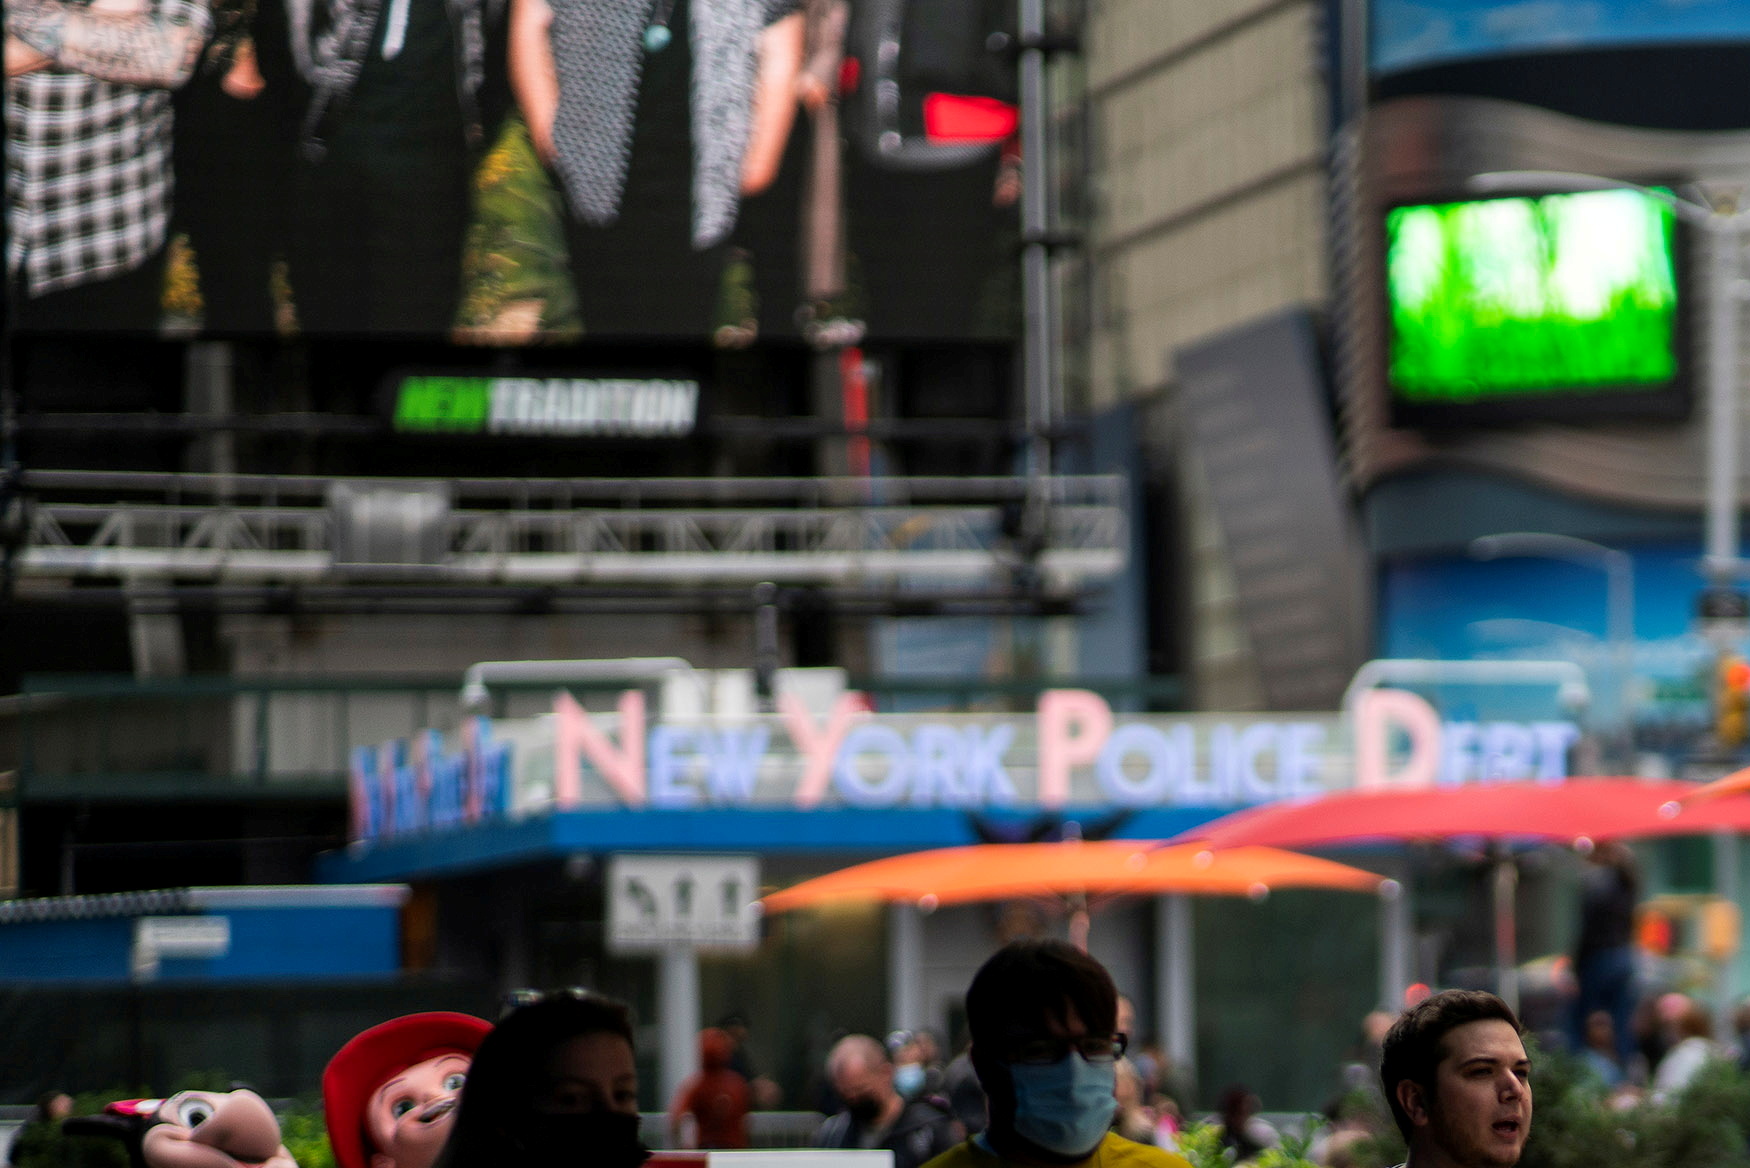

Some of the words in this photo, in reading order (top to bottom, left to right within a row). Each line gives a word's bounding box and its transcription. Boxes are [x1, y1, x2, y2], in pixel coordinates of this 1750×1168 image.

[551, 690, 771, 809] NEW
[776, 689, 1019, 808] YORK
[1035, 687, 1327, 806] POLICE
